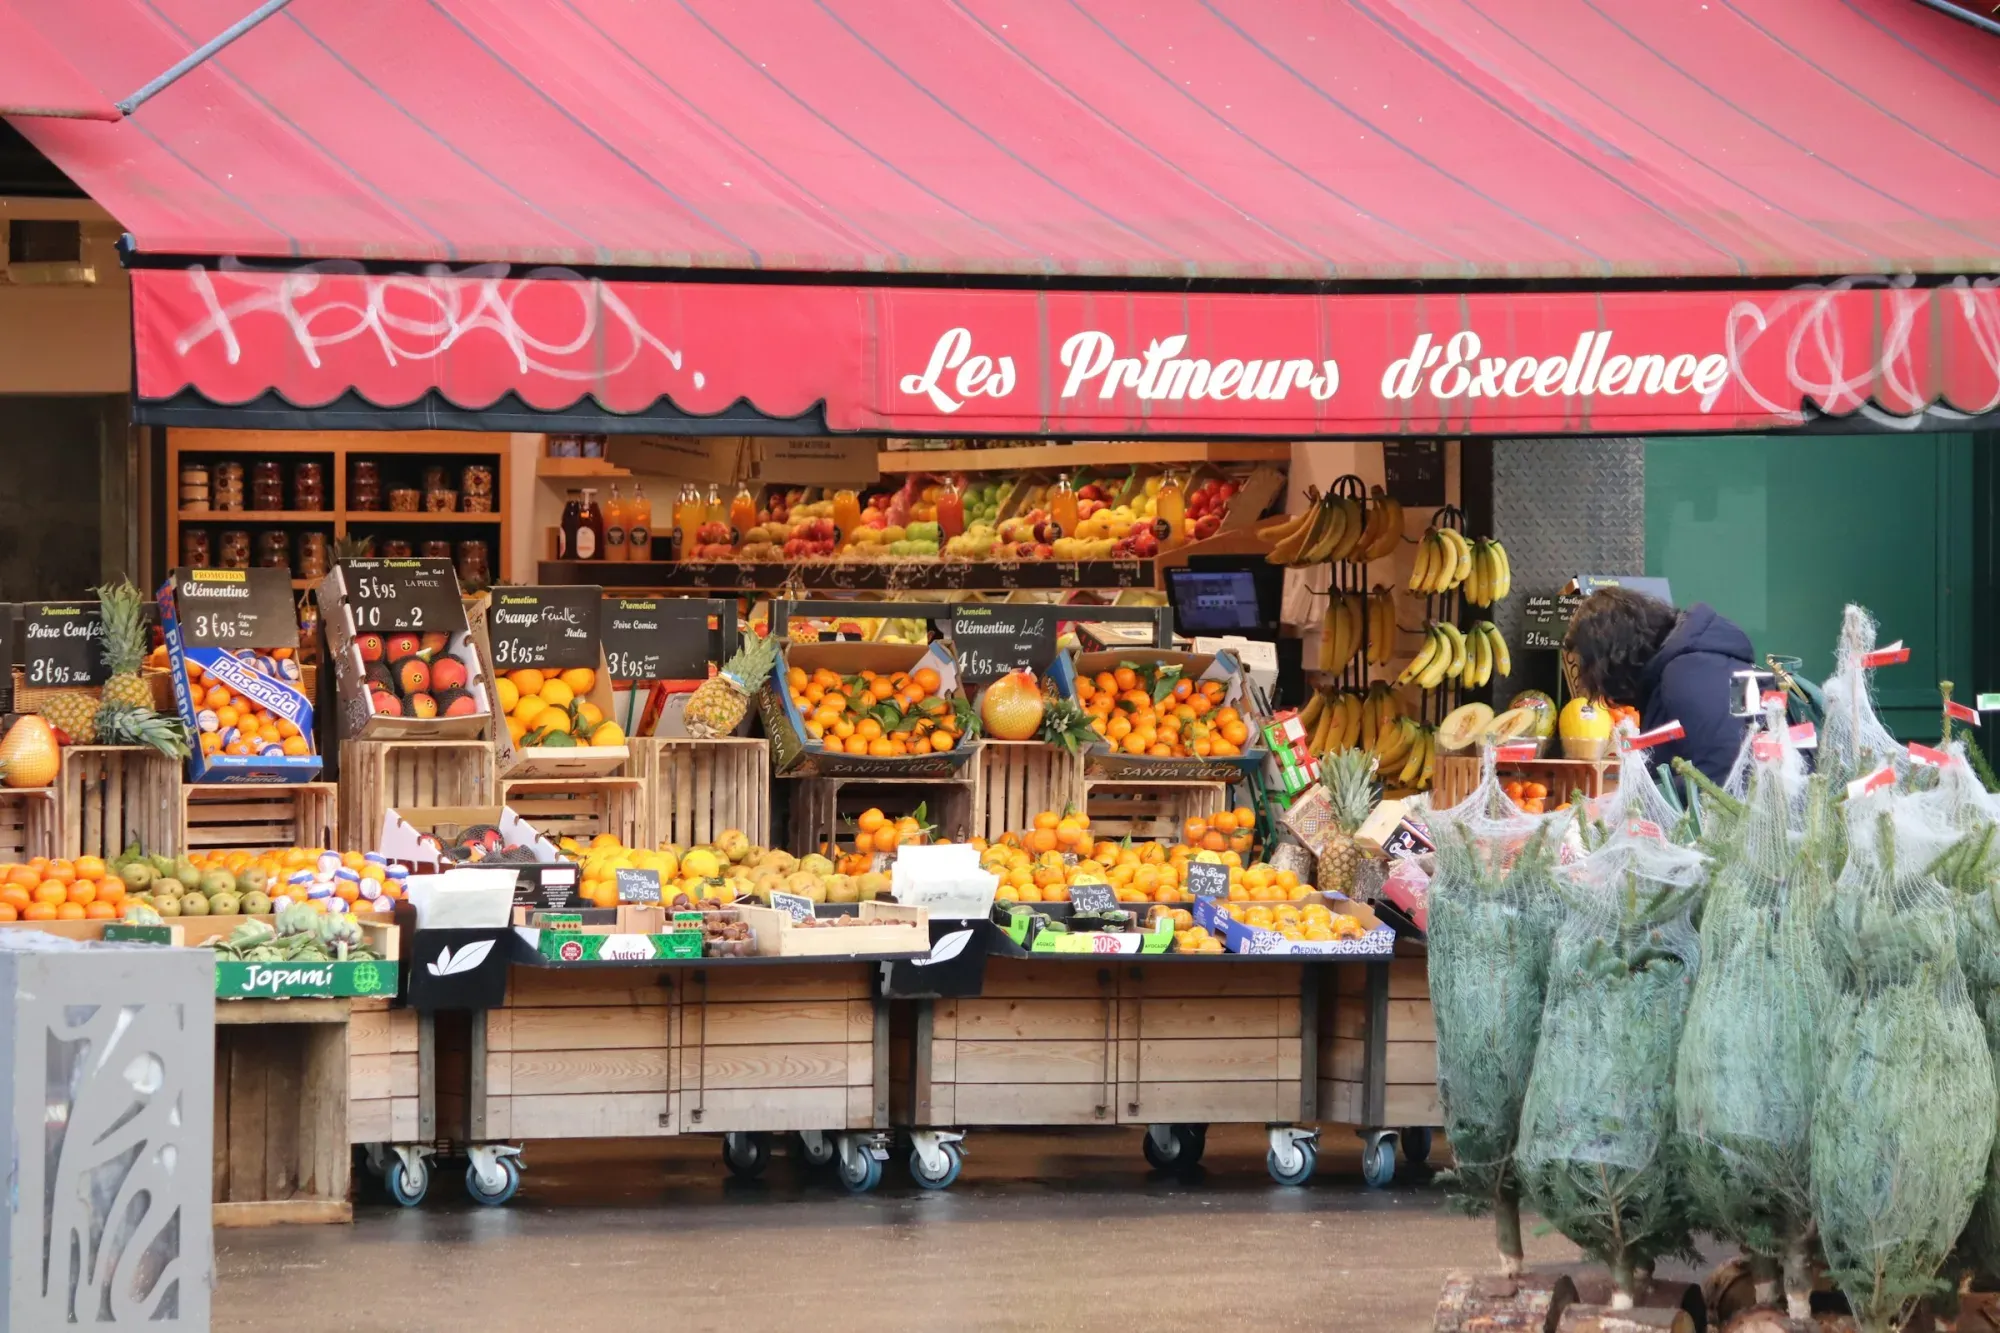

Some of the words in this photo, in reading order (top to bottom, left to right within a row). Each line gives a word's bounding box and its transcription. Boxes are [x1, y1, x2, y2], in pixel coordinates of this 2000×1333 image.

[900, 327, 1016, 413] Les
[1060, 330, 1339, 400] Primeurs
[1381, 330, 1728, 400] d'Excellence
[384, 559, 421, 568] Promotion
[192, 570, 245, 580] PROMOTION
[183, 582, 249, 597] Clémentine
[500, 594, 538, 605] Promotion
[620, 600, 656, 610] Promotion
[41, 606, 80, 616] Promotion
[356, 606, 380, 626] 10
[411, 606, 423, 626] 2
[956, 606, 992, 616] Promotion
[495, 608, 539, 628] Orange
[27, 622, 60, 638] Poire
[612, 620, 631, 629] Poire
[633, 620, 658, 630] Comice
[955, 619, 1015, 635] Clémentine
[564, 628, 587, 638] Italia
[72, 671, 91, 681] Kilo
[212, 660, 299, 715] Plasencia
[830, 763, 892, 773] SANTA
[1119, 767, 1179, 777] SANTA
[1186, 768, 1242, 777] LUCIA
[1290, 945, 1323, 954] MEDINA
[609, 950, 646, 960] Auteri
[242, 963, 334, 993] Jopami
